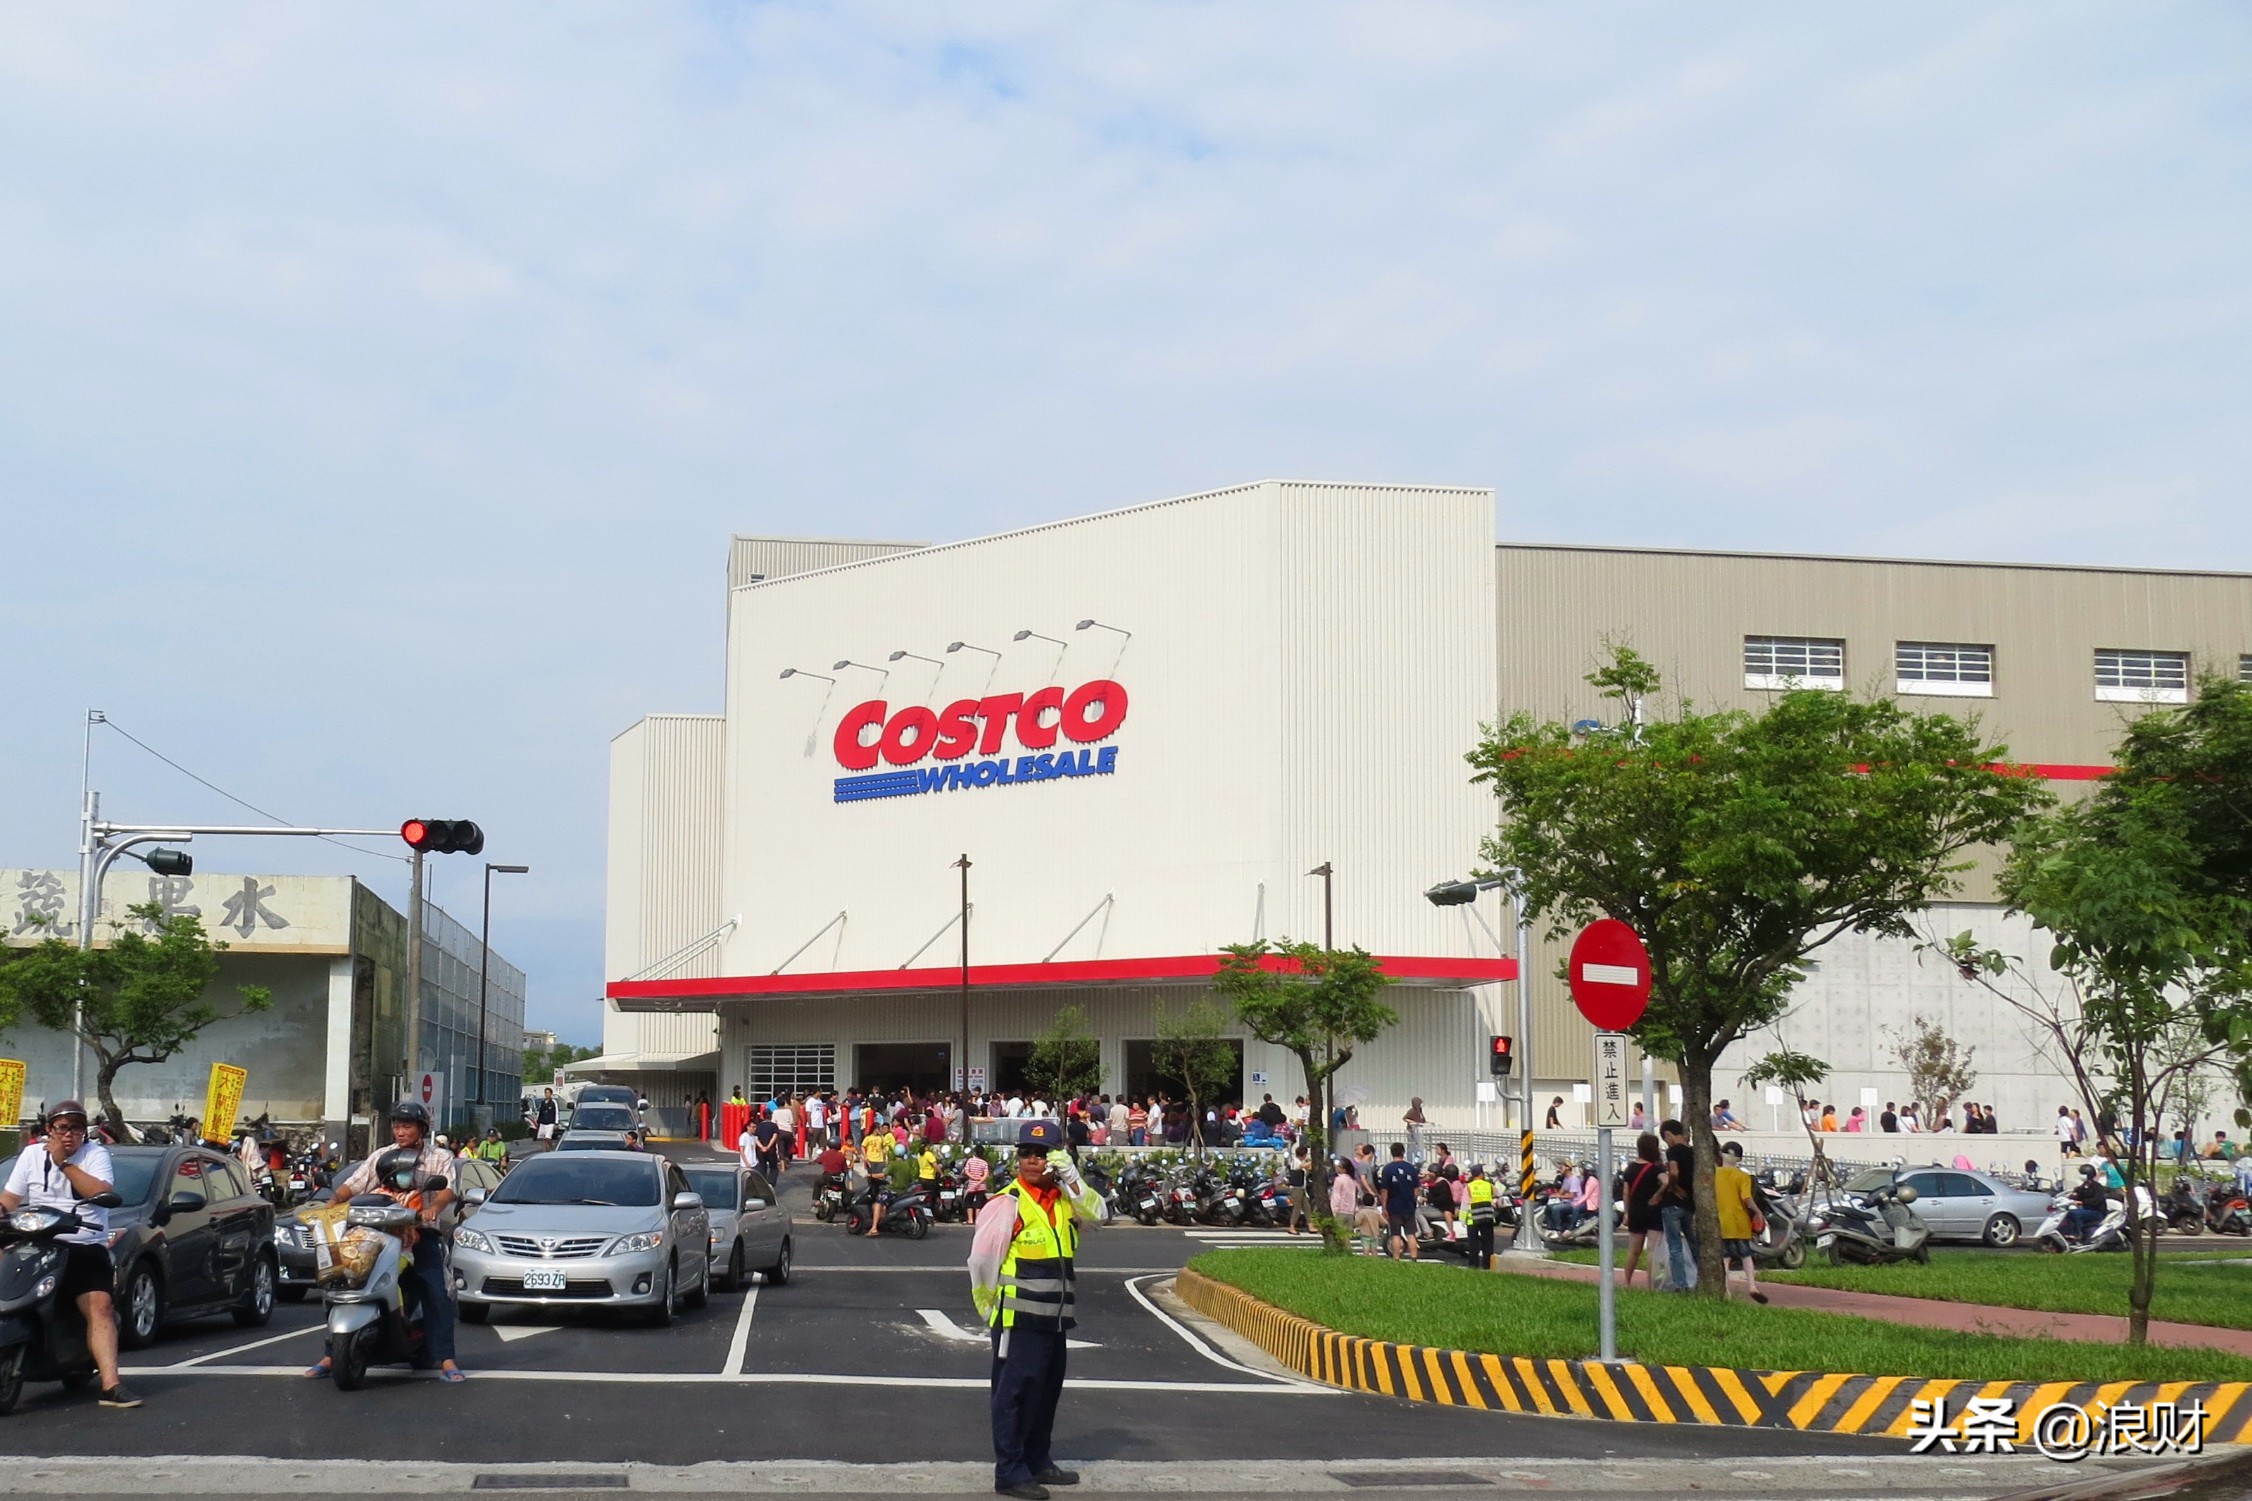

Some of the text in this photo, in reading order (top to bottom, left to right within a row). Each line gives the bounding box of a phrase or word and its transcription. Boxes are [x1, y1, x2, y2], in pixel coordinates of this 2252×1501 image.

[834, 679, 1128, 770] COSTCO
[917, 746, 1118, 794] WHOLESALE
[1602, 1040, 1621, 1121] 禁止進入
[525, 1273, 550, 1286] 2693
